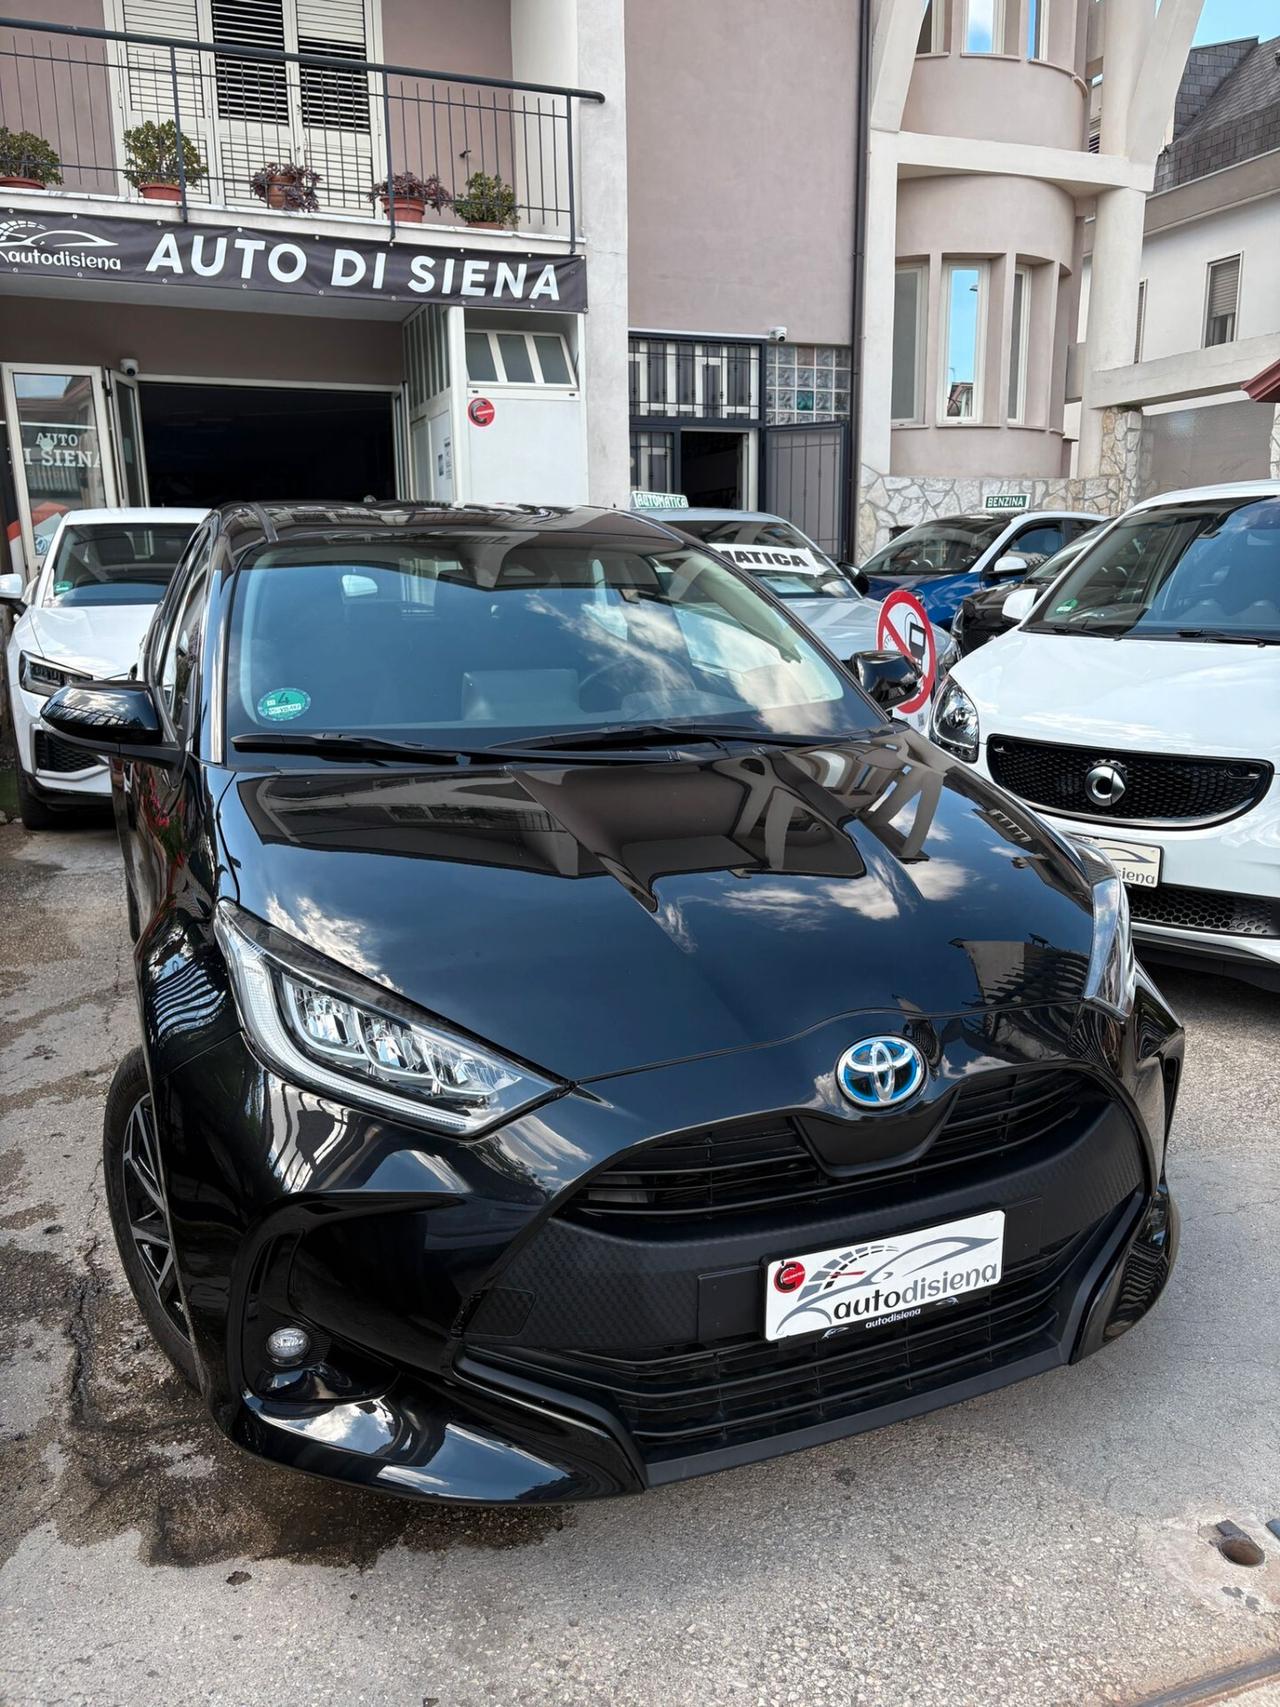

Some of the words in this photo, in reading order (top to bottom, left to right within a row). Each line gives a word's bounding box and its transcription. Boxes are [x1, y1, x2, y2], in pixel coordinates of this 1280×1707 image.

[8, 249, 121, 270] autodisiena
[145, 232, 307, 284] AUTO
[330, 248, 386, 290] DI
[407, 256, 560, 301] SIENA
[35, 432, 78, 447] AUTO
[637, 493, 688, 508] AUTOMATICA
[987, 496, 1024, 507] BENZINA
[1118, 867, 1155, 885] iena
[833, 1262, 998, 1320] autodisiena
[865, 1306, 922, 1329] autodisiena
